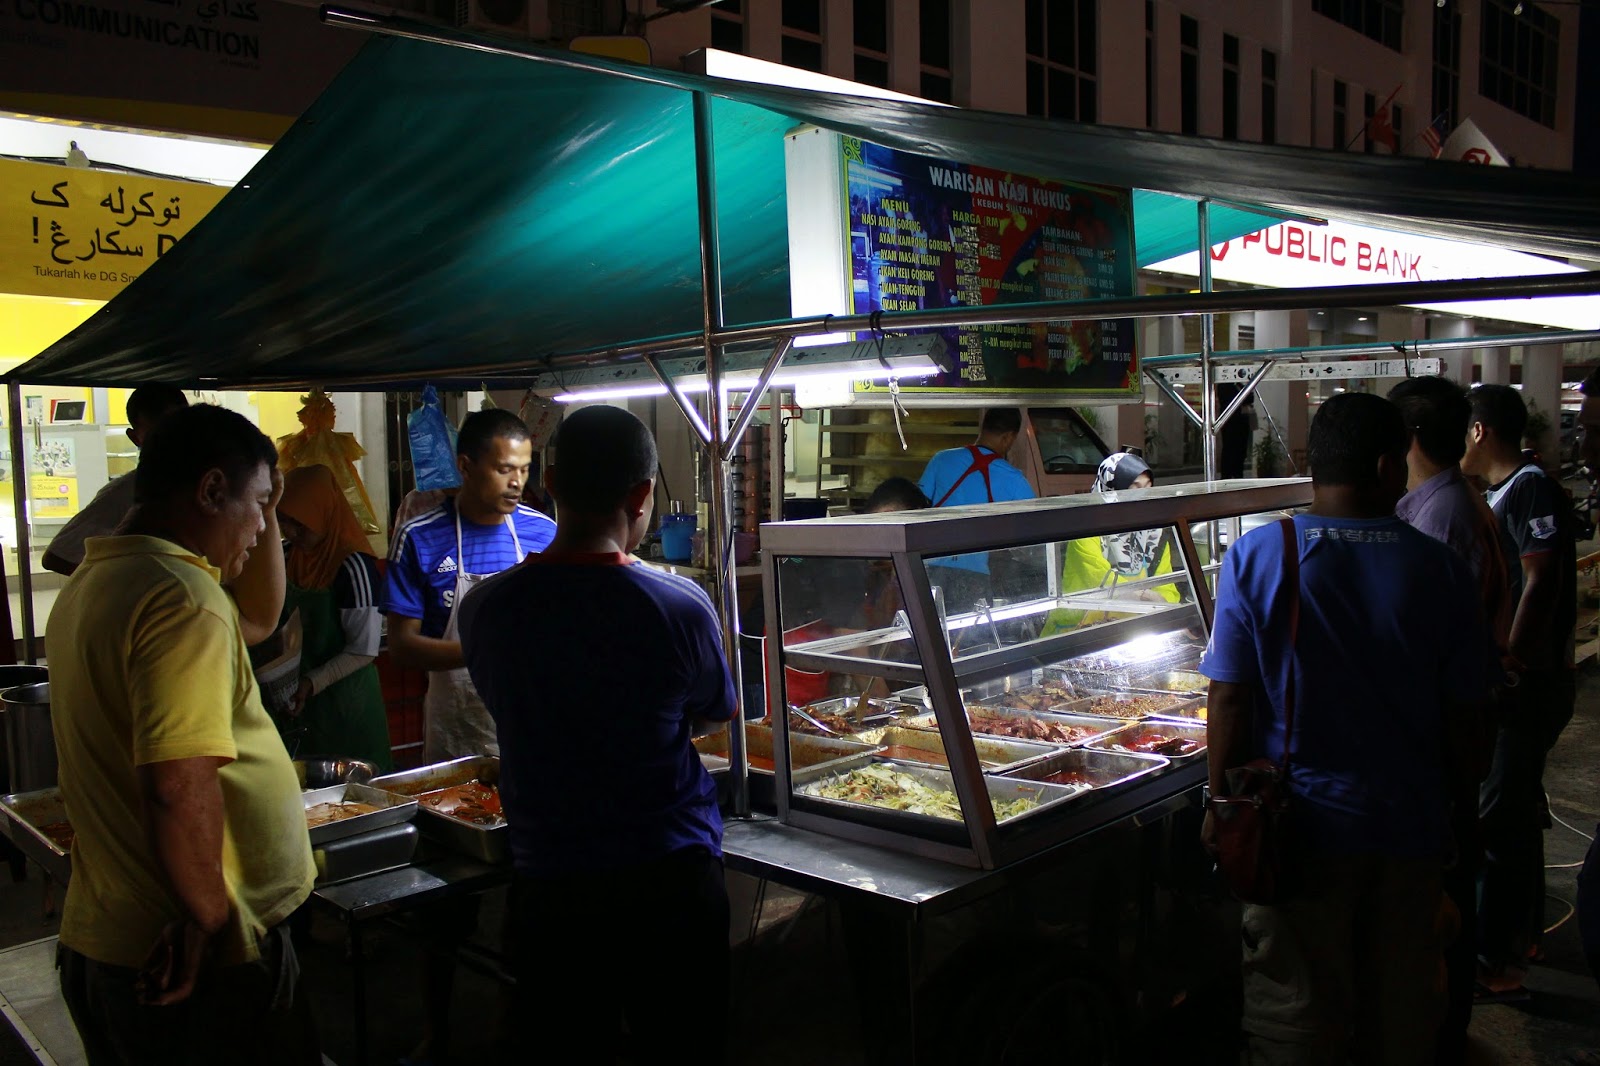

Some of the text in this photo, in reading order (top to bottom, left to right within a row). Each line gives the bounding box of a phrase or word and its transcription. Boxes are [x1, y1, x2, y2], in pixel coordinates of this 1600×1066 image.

[16, 0, 259, 59] COMMUNICATION
[928, 166, 995, 197] WARISAN
[1032, 187, 1072, 212] KUKUS
[881, 198, 909, 214] MENU
[977, 198, 1004, 211] KEBUN
[1005, 203, 1034, 216] SULTAN
[861, 213, 921, 232] NASI AYAM GORENG
[951, 210, 982, 226] HARGA
[879, 232, 952, 253] AYAM KAMPONG GORENG
[1041, 226, 1083, 242] TAMBAHAN:
[880, 249, 941, 267] AYAM MASAK MERAH
[1243, 224, 1421, 281] PUBLIC BANK
[33, 265, 81, 279] Tukarlah
[83, 271, 97, 281] ke
[99, 272, 118, 282] DG
[881, 265, 935, 282] IKAN KELI GORENG
[881, 281, 926, 297] IKAN TENGGIRI
[882, 297, 917, 312] IKAN SELAR
